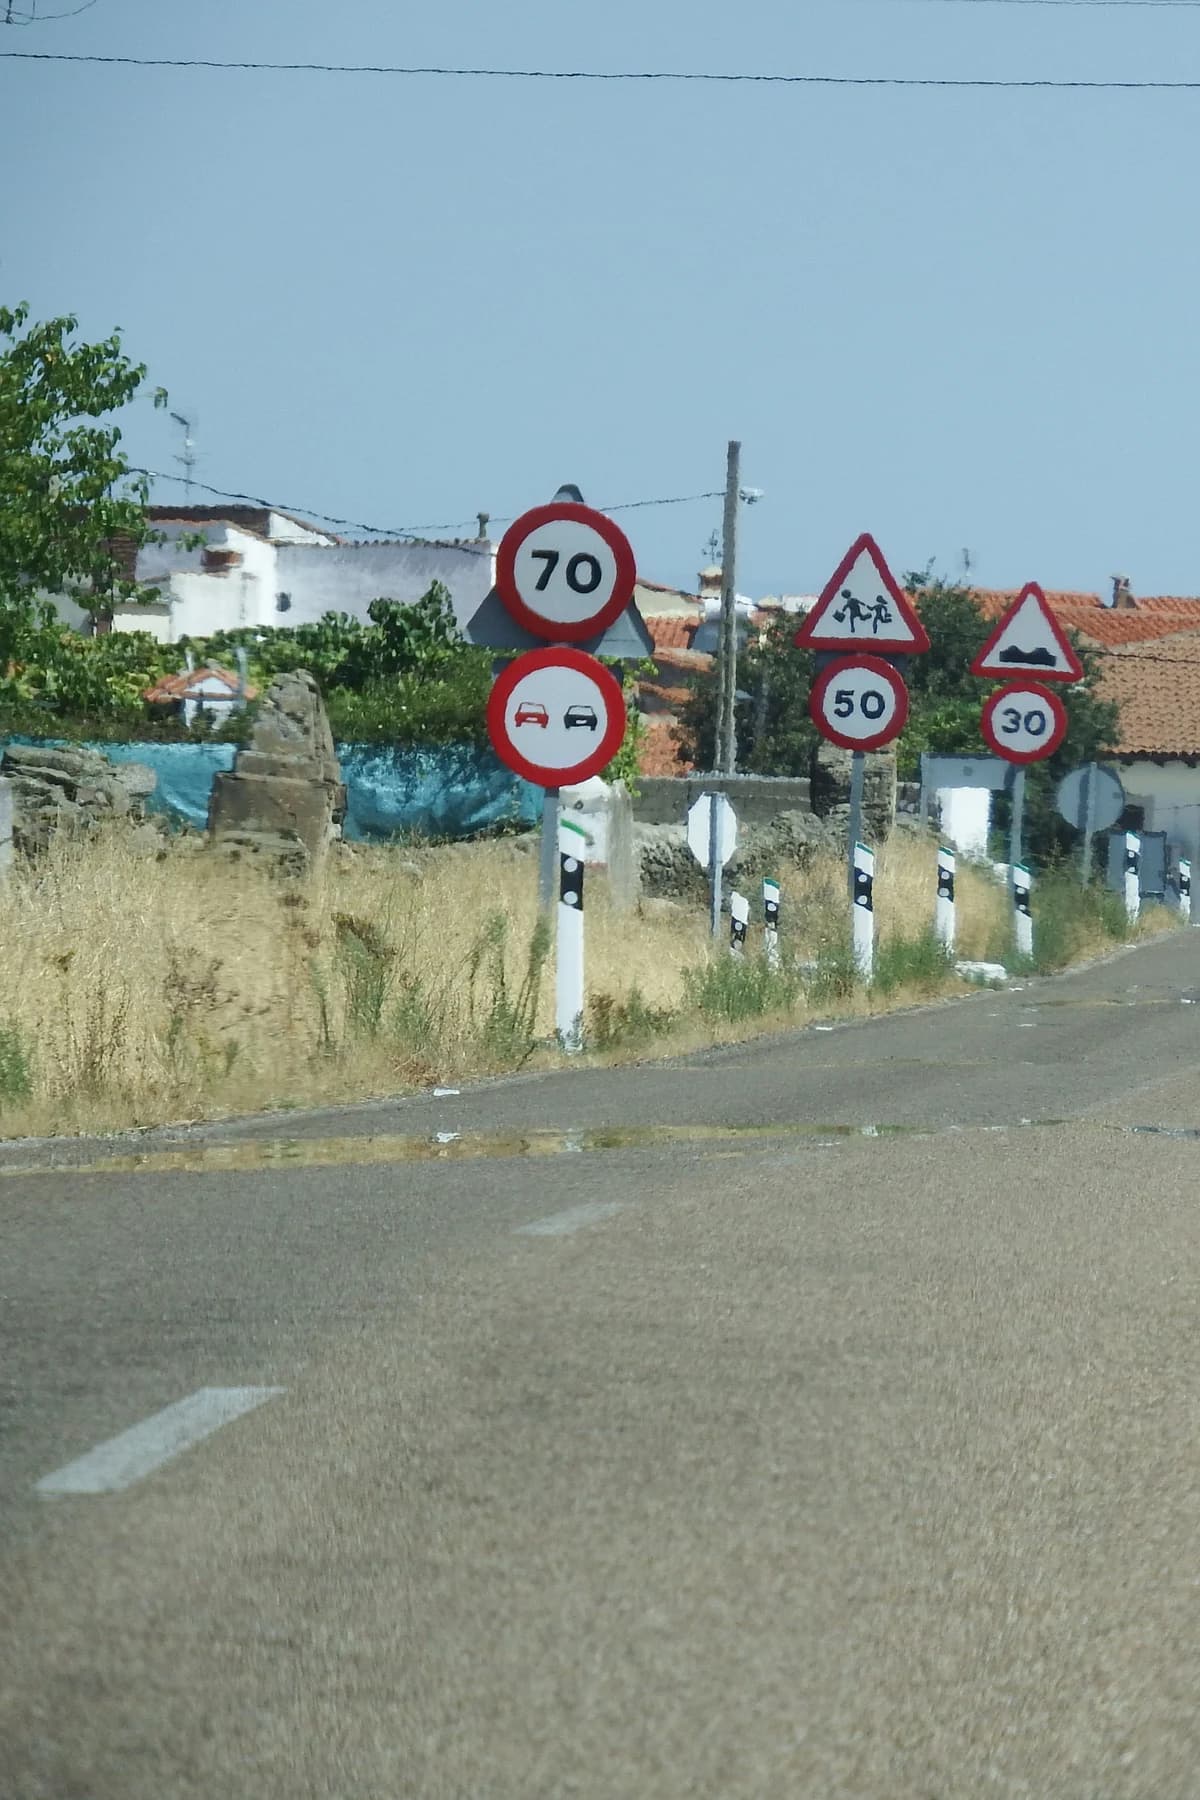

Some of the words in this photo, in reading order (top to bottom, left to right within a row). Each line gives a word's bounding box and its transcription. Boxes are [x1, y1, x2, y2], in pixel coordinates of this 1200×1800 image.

[531, 549, 602, 594] 70
[834, 690, 886, 720] 50
[1001, 708, 1046, 736] 30
